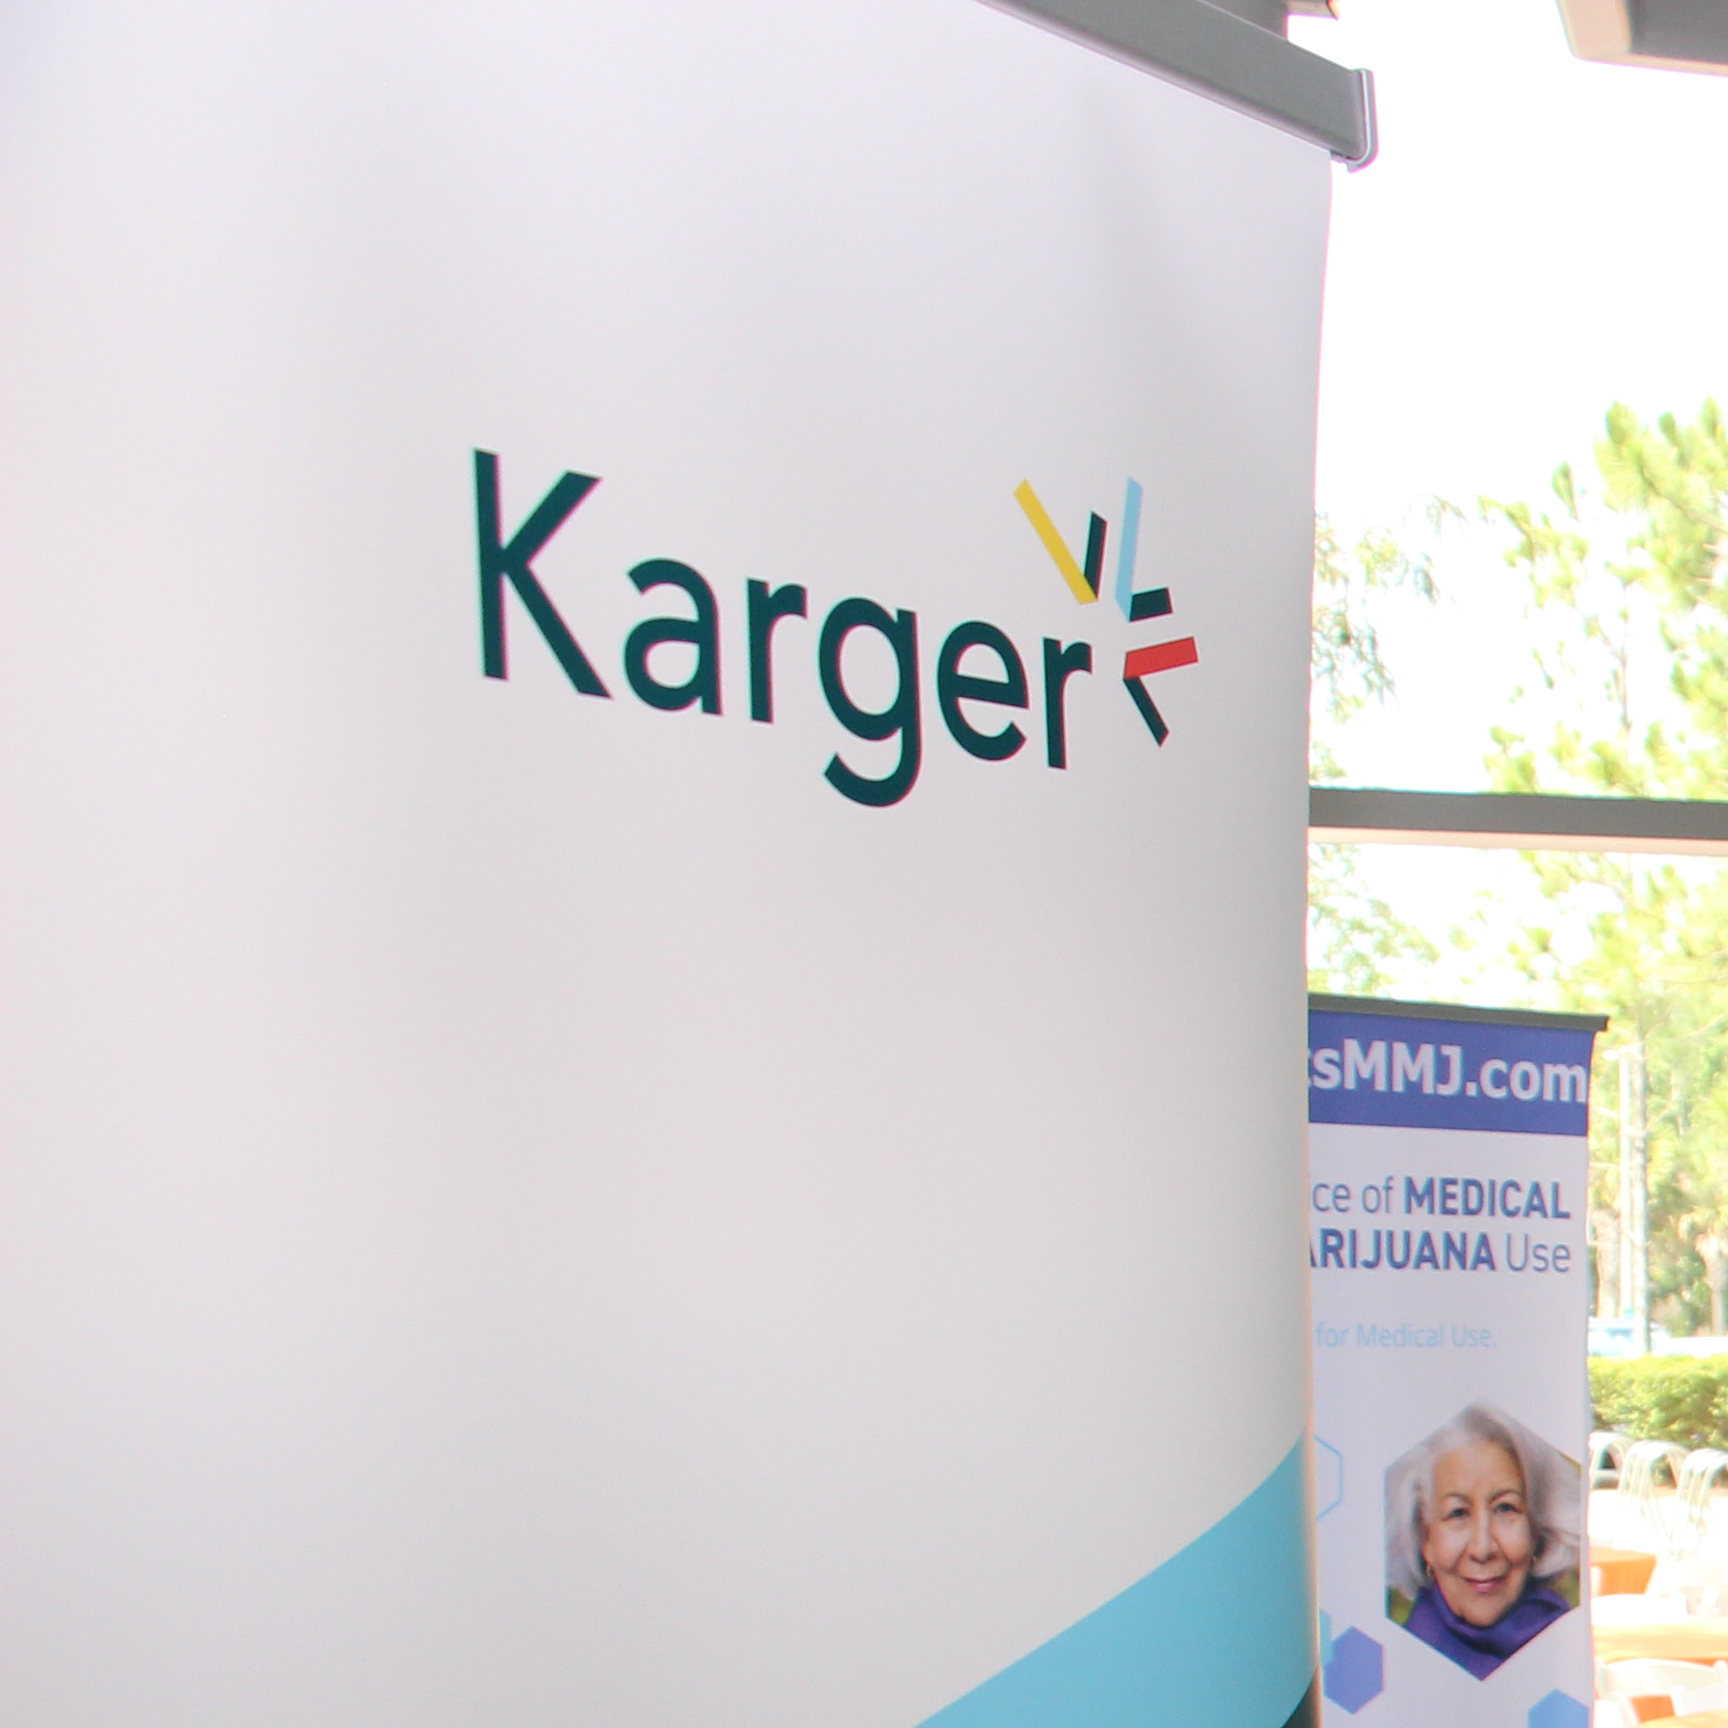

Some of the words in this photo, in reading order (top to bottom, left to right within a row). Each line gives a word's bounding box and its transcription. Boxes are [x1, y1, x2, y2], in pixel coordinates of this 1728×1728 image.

[474, 447, 1094, 808] Karger
[1308, 1037, 1588, 1103] sMMJ.com
[1361, 1175, 1395, 1214] of
[1403, 1176, 1571, 1219] MEDICAL
[1309, 1227, 1497, 1272] RIJUANA
[1505, 1233, 1571, 1274] Use
[1316, 1321, 1347, 1347] for
[1356, 1321, 1445, 1349] Medical
